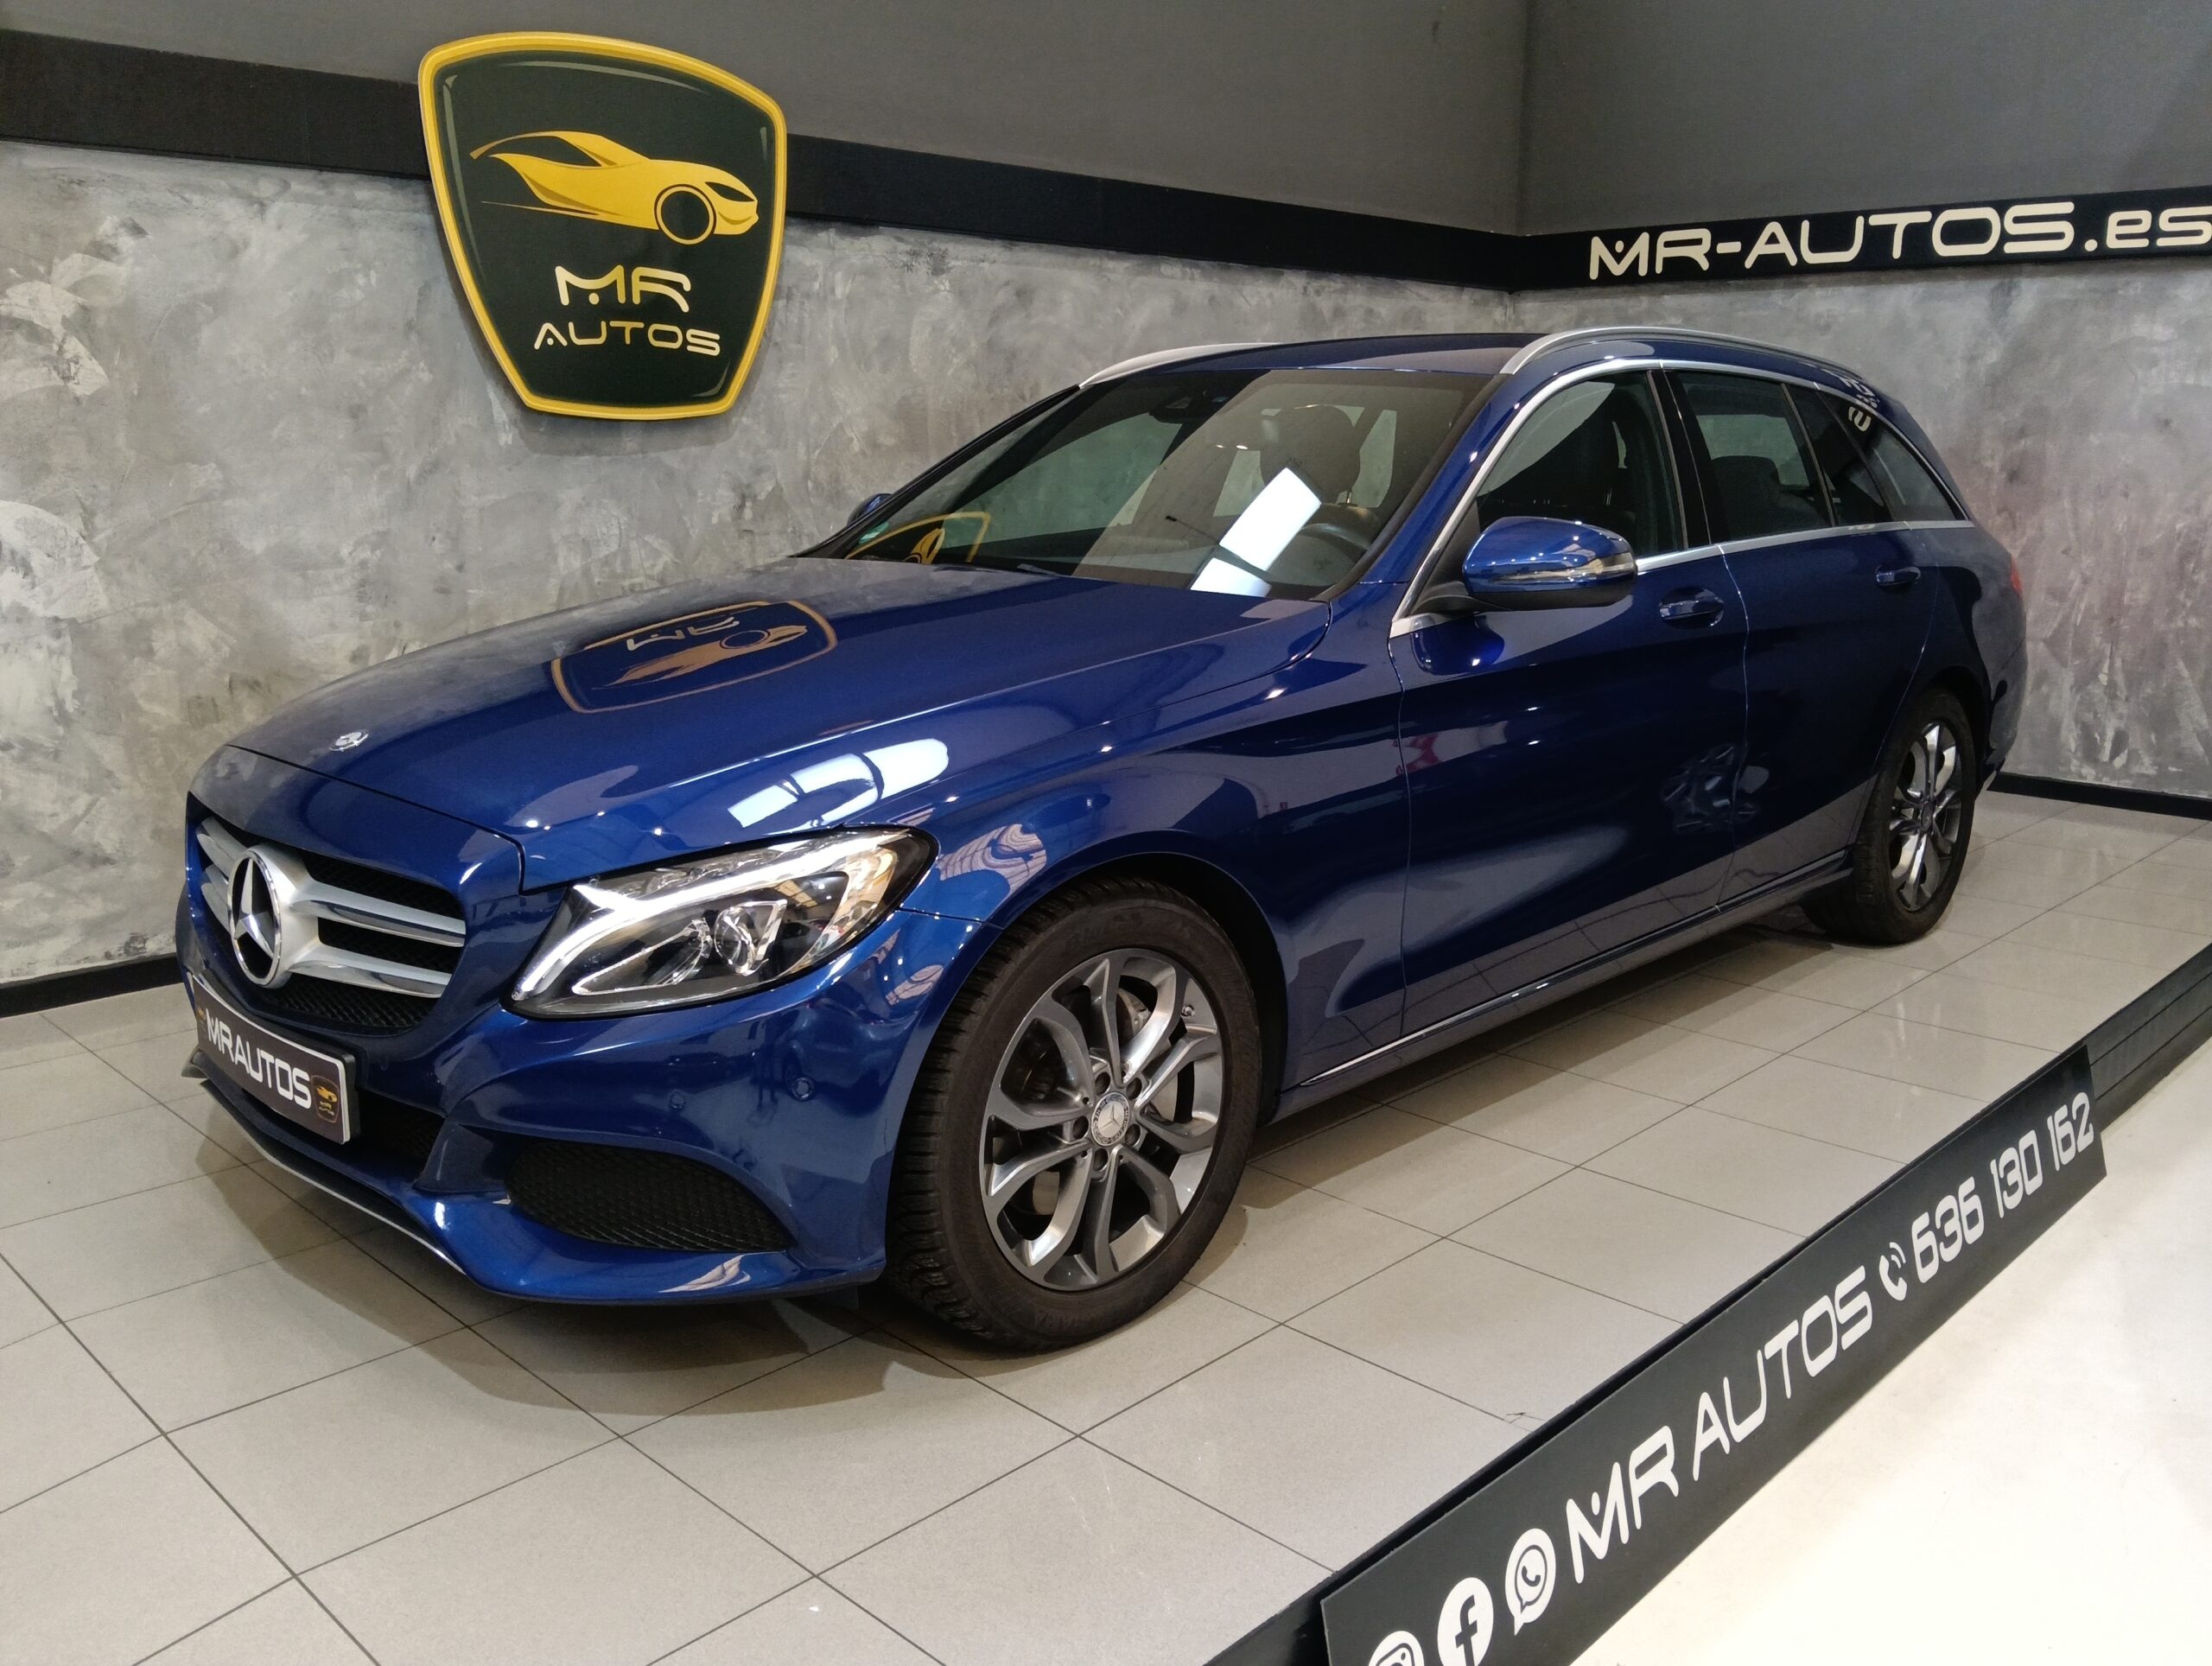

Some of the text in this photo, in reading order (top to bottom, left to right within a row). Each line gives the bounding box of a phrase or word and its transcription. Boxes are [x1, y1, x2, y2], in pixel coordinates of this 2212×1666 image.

[1589, 201, 2212, 280] MR-AUTOS.es
[555, 264, 691, 313] MR
[534, 321, 721, 357] AUTOS
[1566, 1091, 2094, 1584] MR AUTOS 636 130 162
